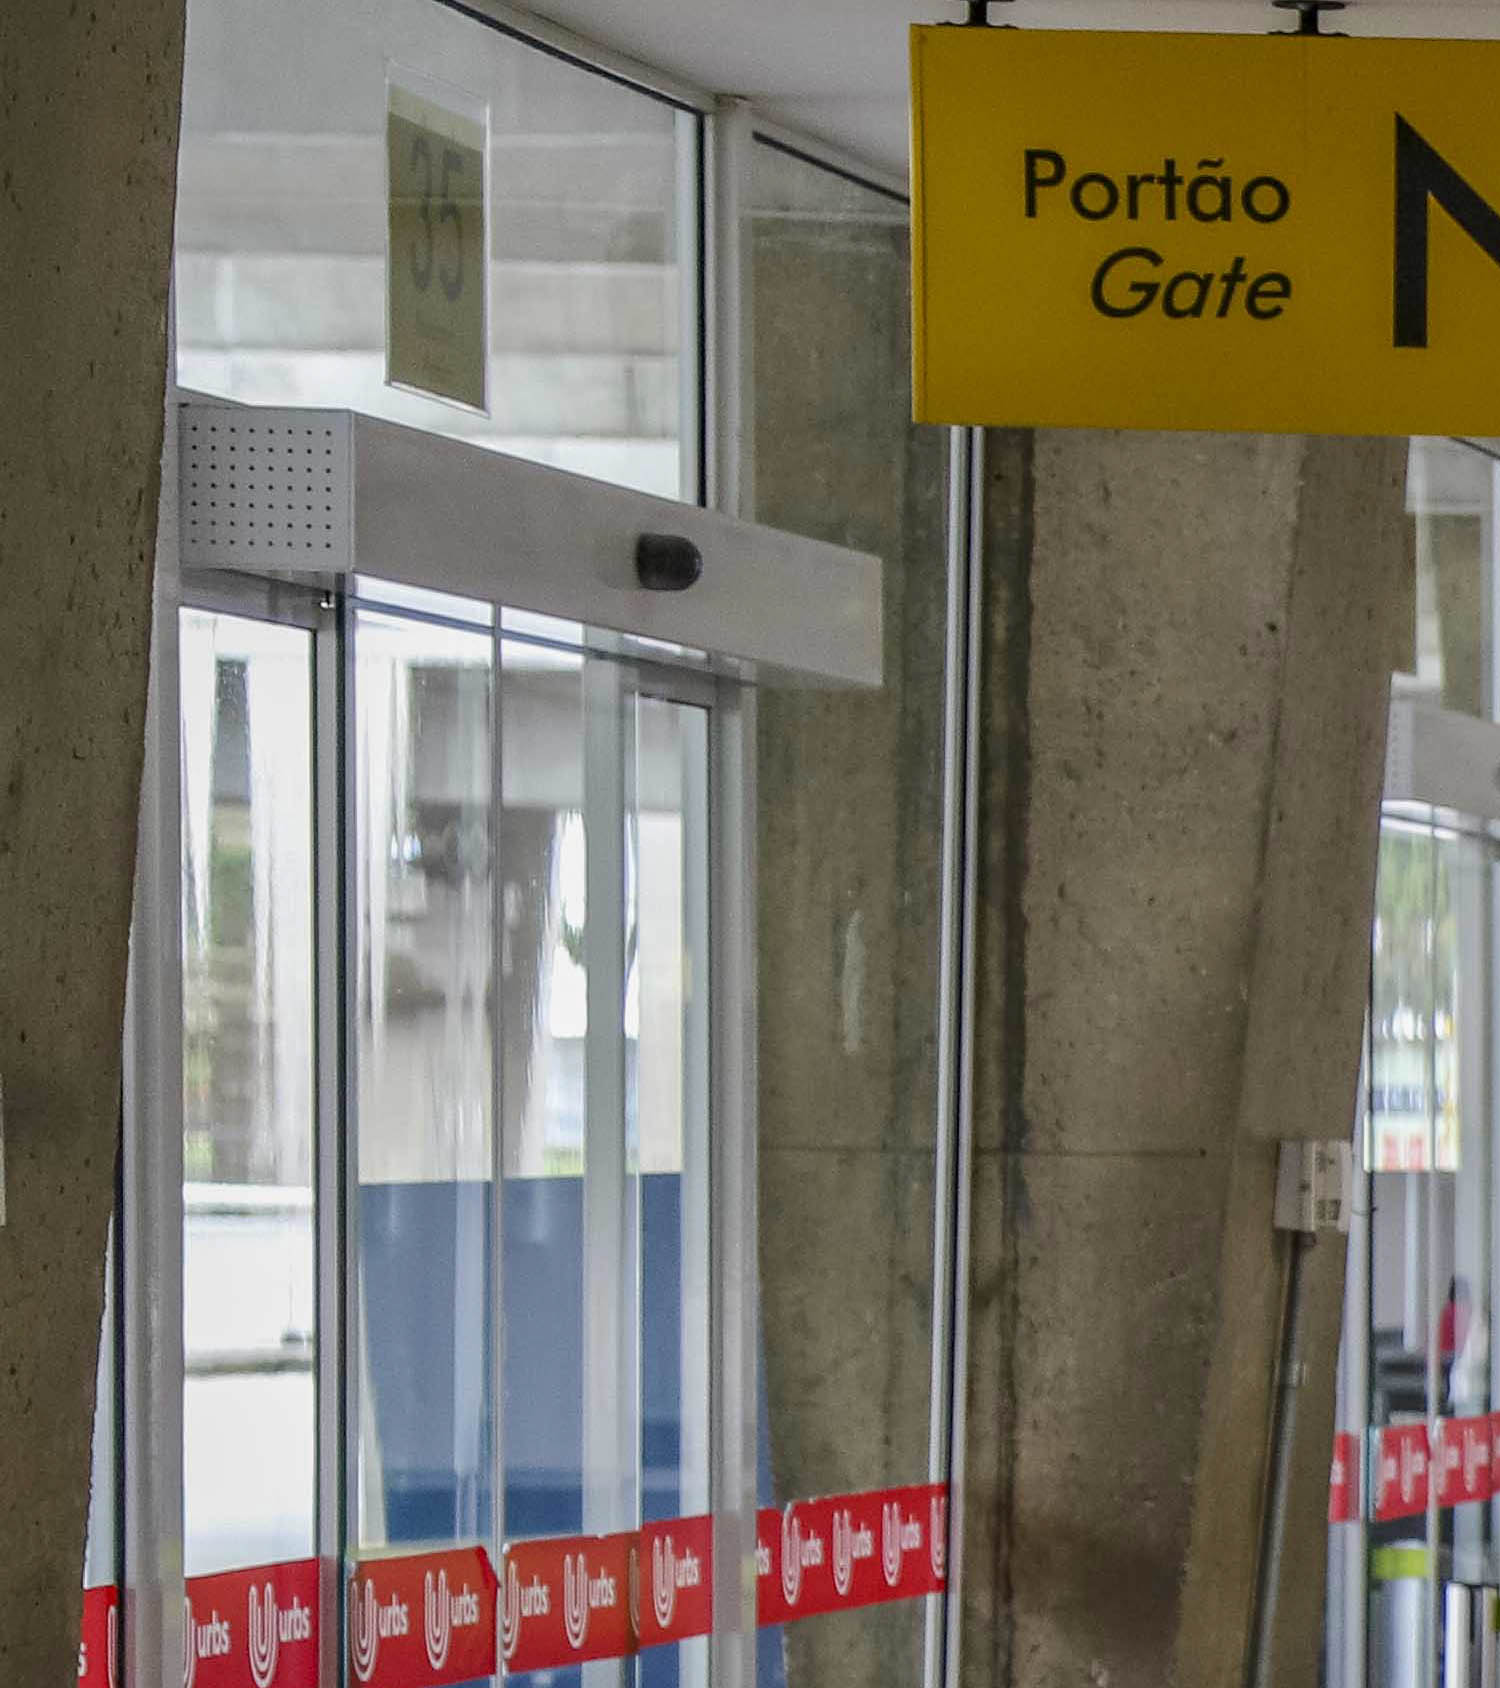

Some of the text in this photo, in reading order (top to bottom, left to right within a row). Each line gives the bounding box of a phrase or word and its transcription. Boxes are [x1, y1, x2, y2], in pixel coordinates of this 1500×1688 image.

[1022, 148, 1292, 223] Portão
[1090, 246, 1293, 324] Gate
[196, 1609, 230, 1658] urbs
[278, 1596, 311, 1643] urbs
[378, 1593, 409, 1637] urbs
[451, 1582, 480, 1627] urbs
[520, 1574, 549, 1617] urbs
[589, 1566, 617, 1608] urbs
